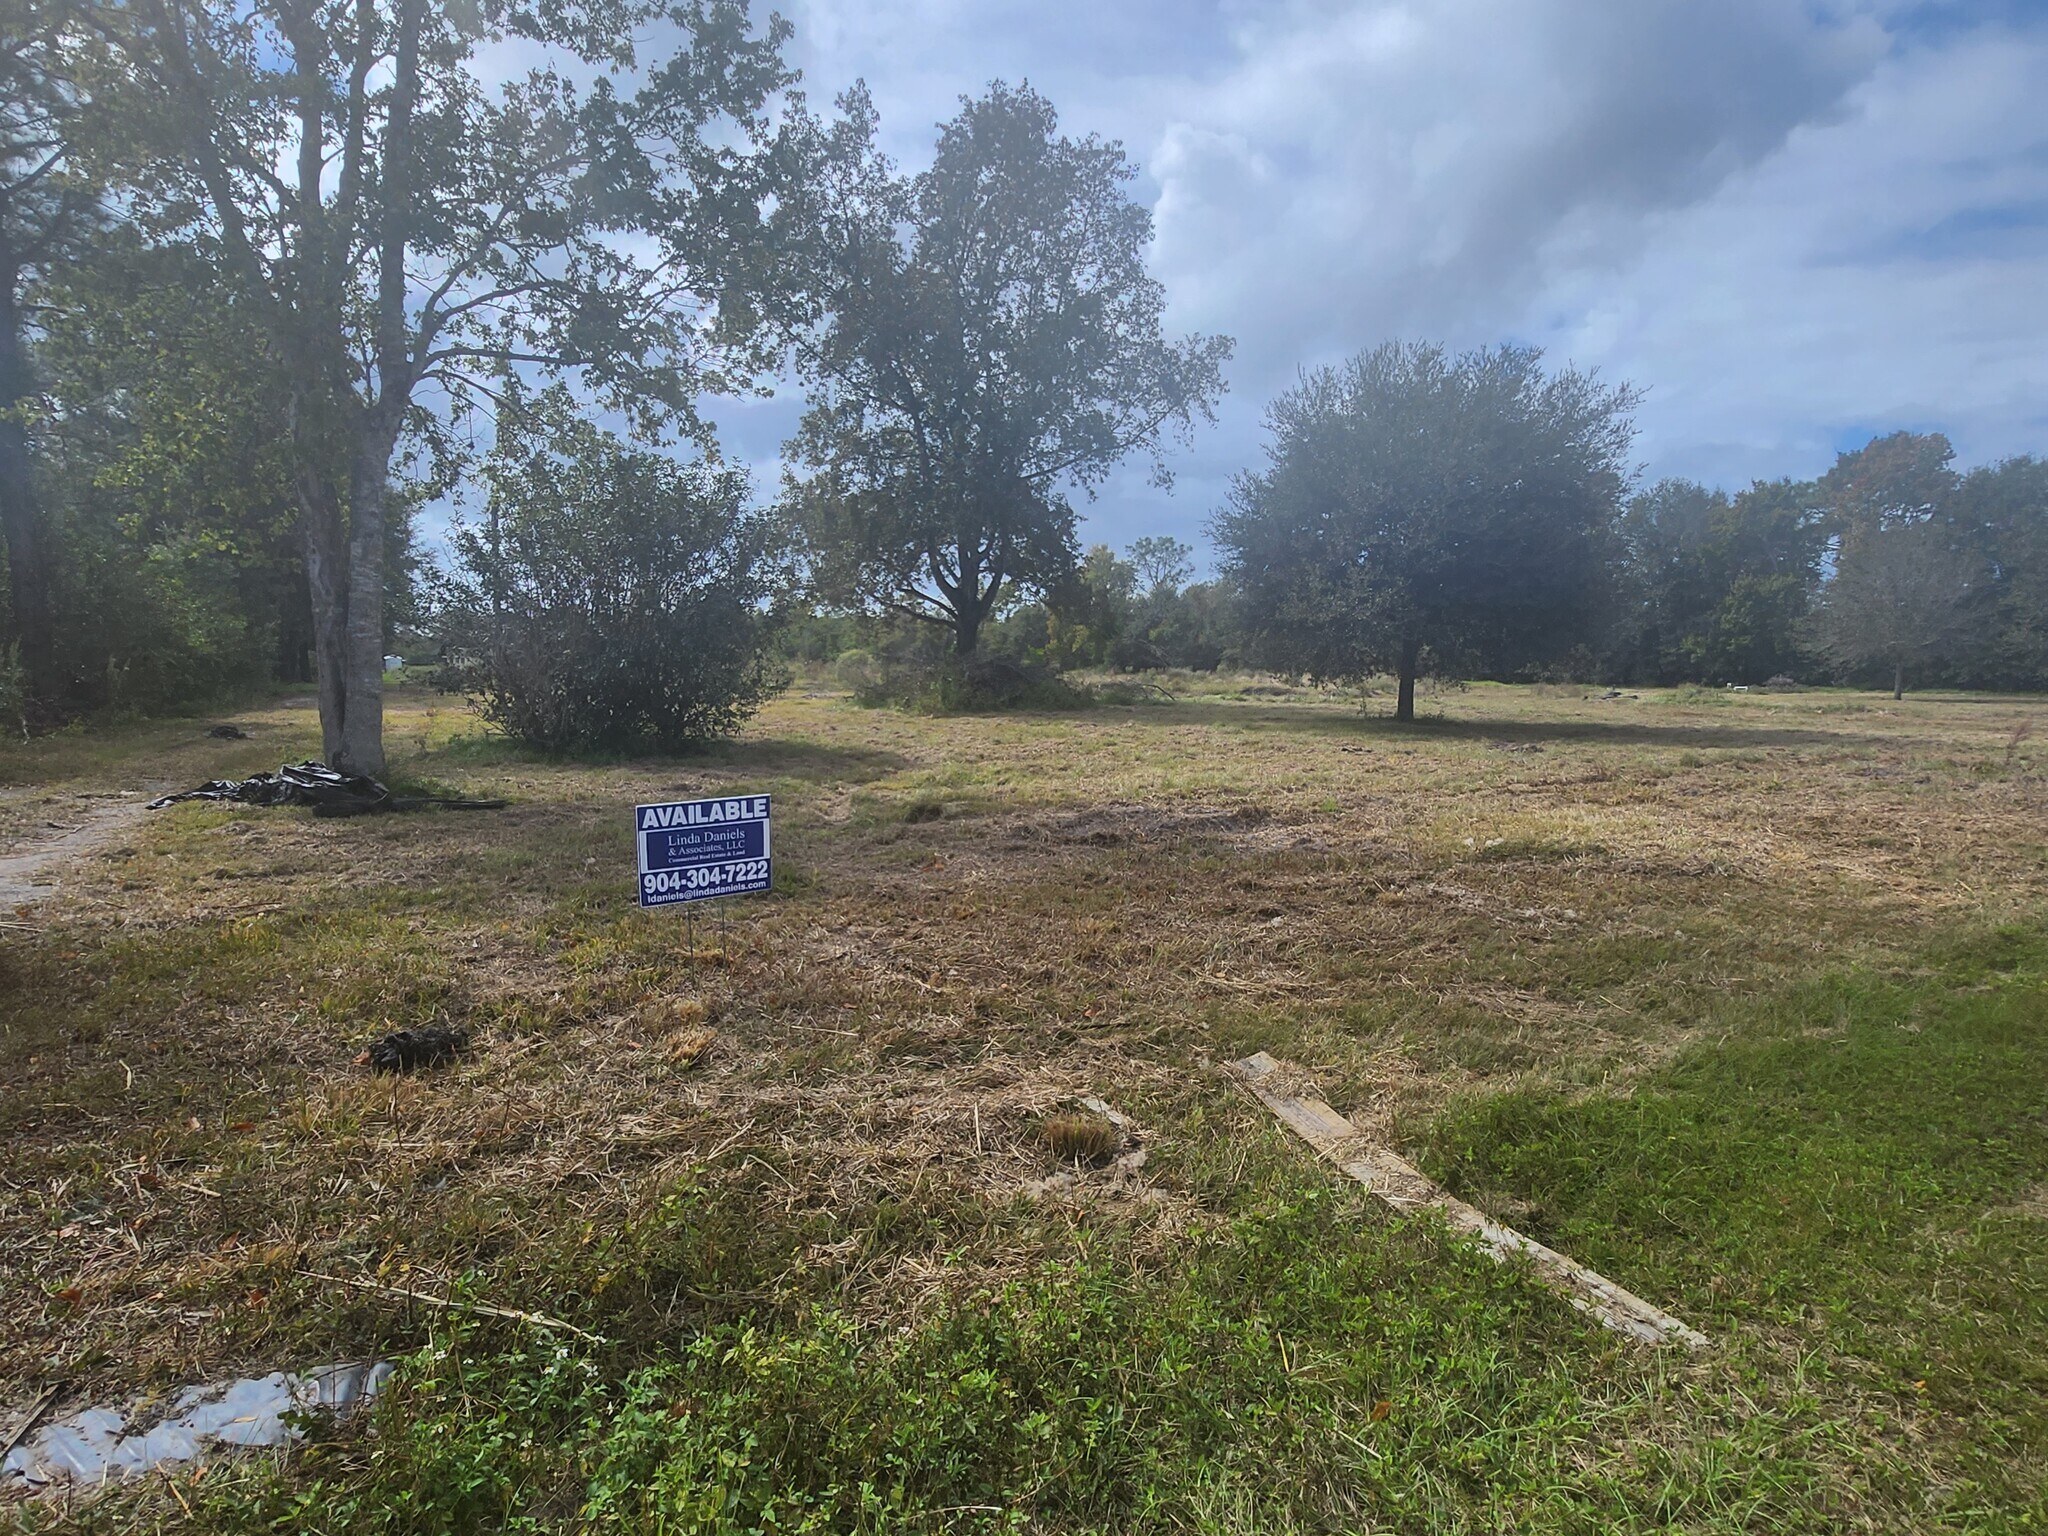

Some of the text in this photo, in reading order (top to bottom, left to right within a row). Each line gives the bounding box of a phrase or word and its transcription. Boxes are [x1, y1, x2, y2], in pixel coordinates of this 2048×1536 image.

[642, 798, 767, 828] AVAILABLE
[668, 828, 745, 846] Linda Daniels
[668, 848, 676, 856] &
[726, 840, 745, 850] LLC
[644, 861, 768, 893] 904-304-7222
[647, 880, 766, 903] ldaniels@lindadaniels.com
